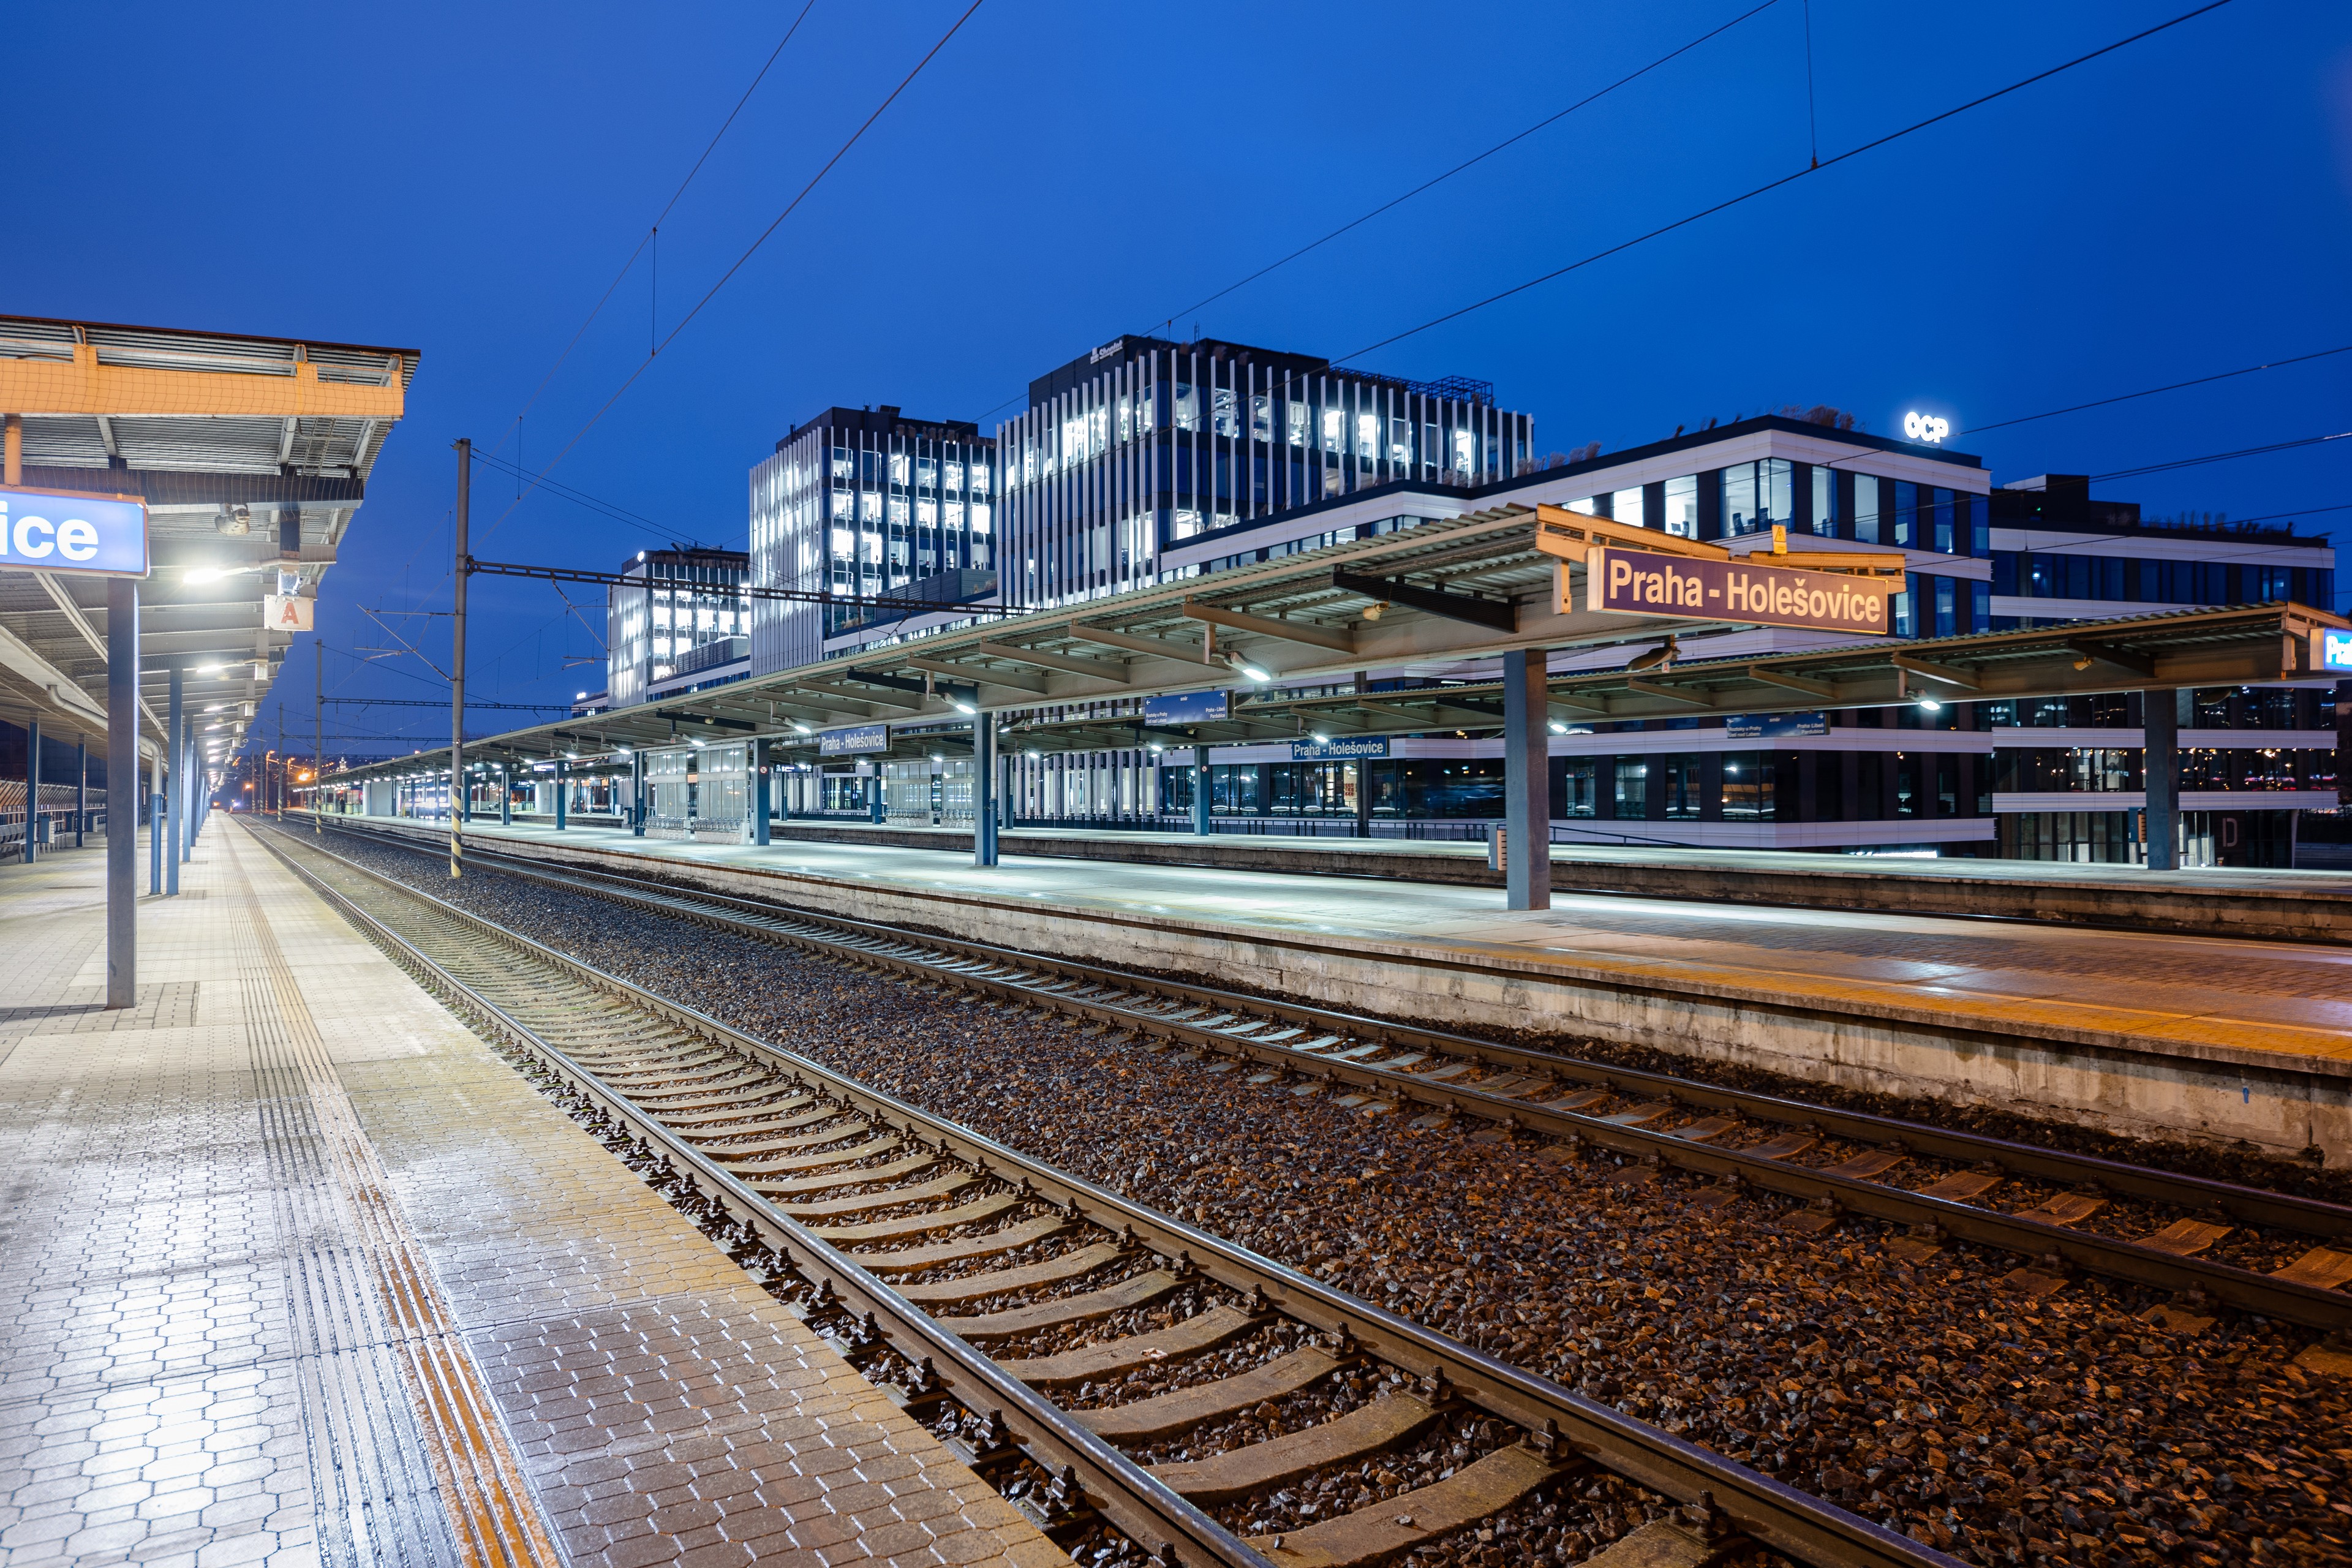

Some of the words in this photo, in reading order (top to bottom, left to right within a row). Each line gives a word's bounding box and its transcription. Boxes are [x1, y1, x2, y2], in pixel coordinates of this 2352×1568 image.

[1610, 559, 1703, 608] Praha
[1709, 589, 1721, 598] -
[1727, 572, 1881, 623] Holešovice
[281, 602, 299, 624] A
[2326, 635, 2352, 665] Pra
[822, 736, 840, 751] Praha
[845, 731, 884, 749] Holešovice
[1294, 744, 1321, 756] Praha
[1329, 741, 1384, 755] Holešovice
[2222, 818, 2238, 847] D
